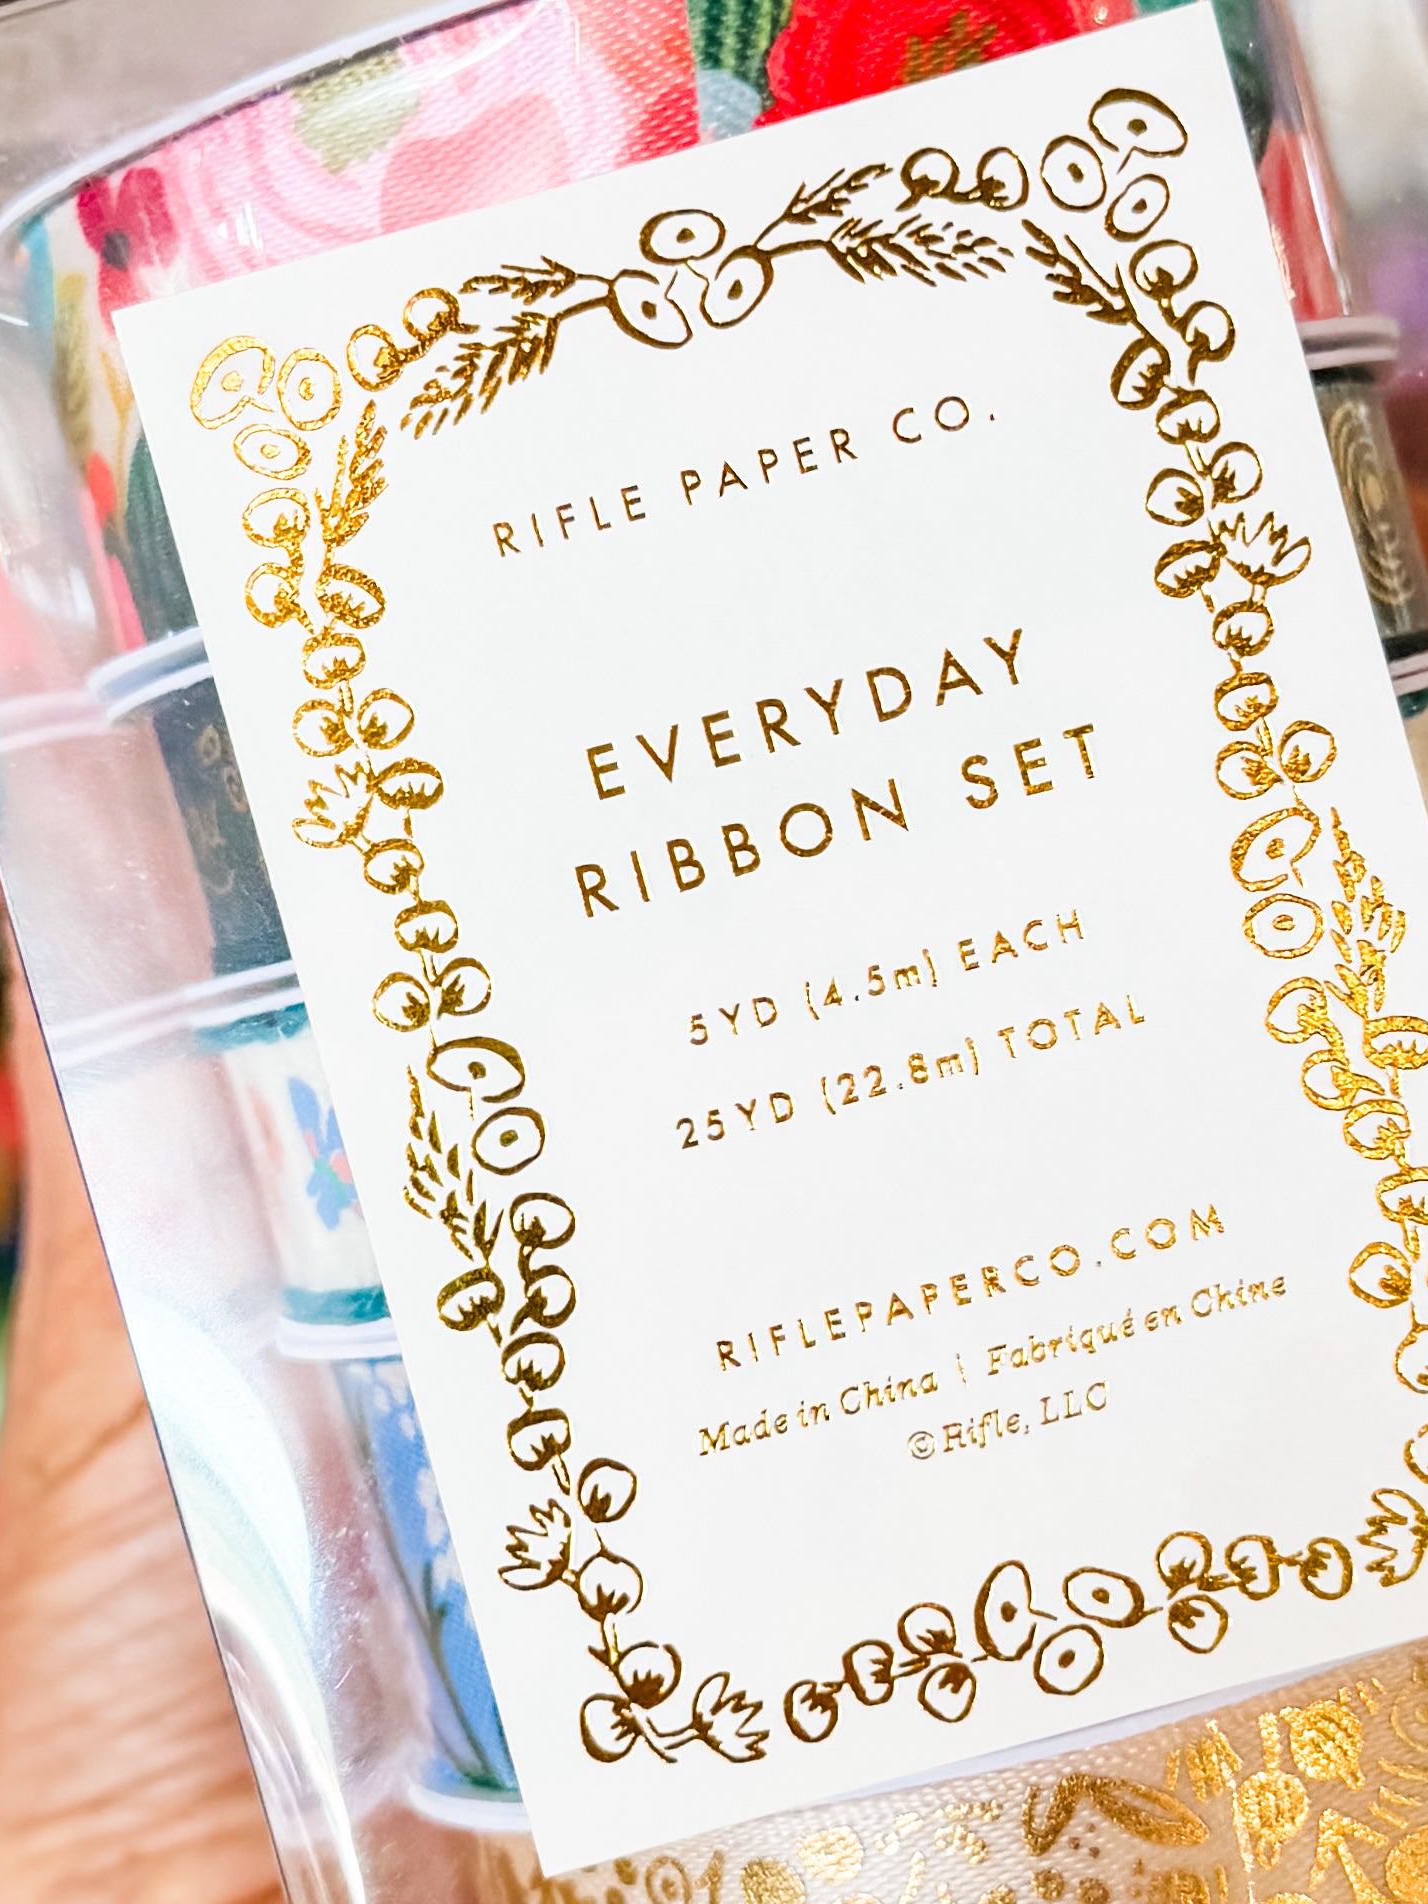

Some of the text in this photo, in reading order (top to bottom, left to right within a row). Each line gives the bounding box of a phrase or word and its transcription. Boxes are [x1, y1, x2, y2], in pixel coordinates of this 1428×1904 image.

[492, 395, 997, 558] RIFLE PAPER CO.
[585, 627, 1023, 801] EVERYDAY
[574, 722, 1096, 918] RIBBON SET
[690, 909, 1084, 1046] 5YD (4.5m) EACH
[675, 994, 1146, 1150] 25YD (22.8m) TOTAL
[698, 1408, 788, 1457] Made
[796, 1400, 830, 1428] in
[839, 1370, 939, 1416] China
[987, 1308, 1135, 1376] Fabriqué
[1144, 1305, 1183, 1333] en
[1190, 1276, 1287, 1318] Chine
[715, 1203, 1225, 1372] RIFLEPAPERCO.COM
[1039, 1381, 1110, 1426] LLC
